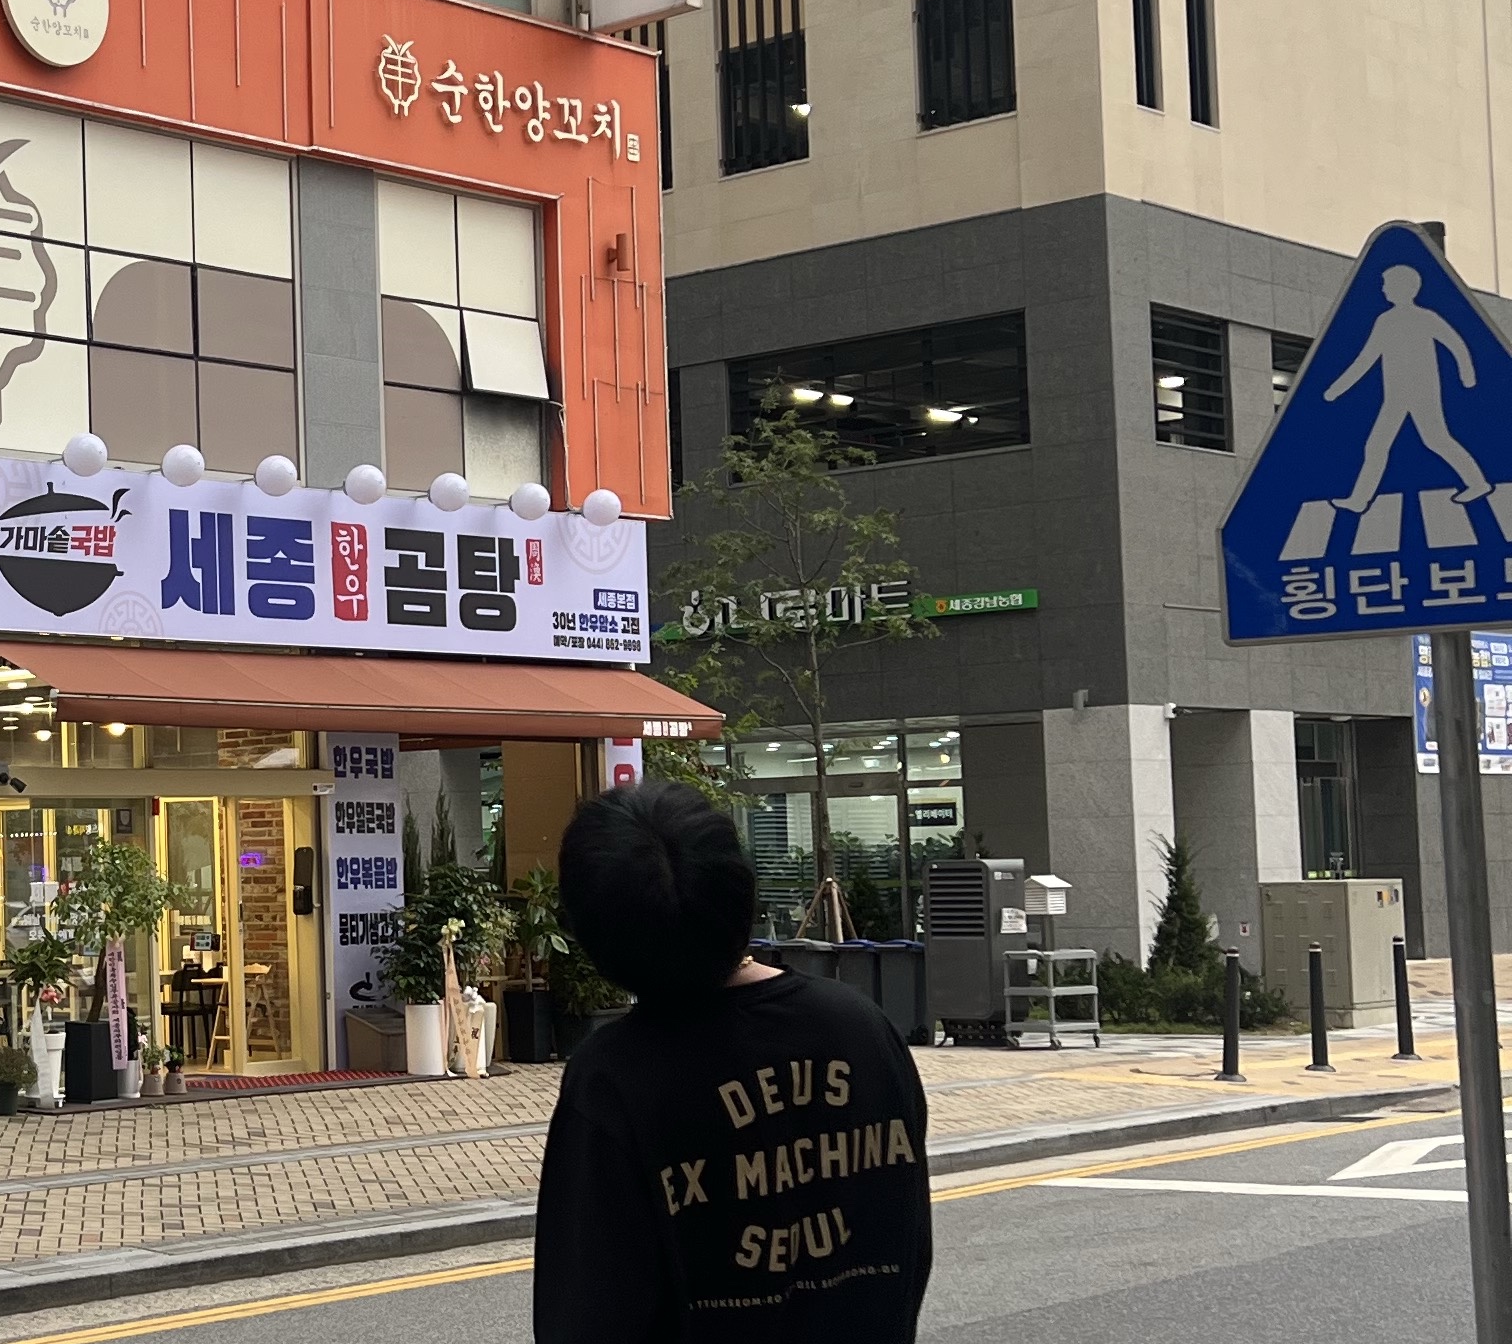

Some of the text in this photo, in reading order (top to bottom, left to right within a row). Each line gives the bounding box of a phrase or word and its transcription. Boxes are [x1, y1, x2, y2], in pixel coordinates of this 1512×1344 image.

[30, 16, 82, 40] 순한양꼬치
[431, 59, 622, 160] 순한양꼬치
[0, 525, 116, 557] 가마솥국밥
[161, 509, 520, 632] 세종 한우 곰탕
[597, 591, 636, 611] 세종본점
[1281, 557, 1512, 620] 횡단보
[552, 612, 576, 631] 30년
[579, 613, 618, 633] 한우암소
[333, 745, 394, 778] 한우국밥
[335, 800, 395, 834] 한우얼큰국밥
[336, 857, 398, 889] 한우볶음밥
[717, 1059, 851, 1129] DEUS
[660, 1118, 916, 1216] EX MACHINA
